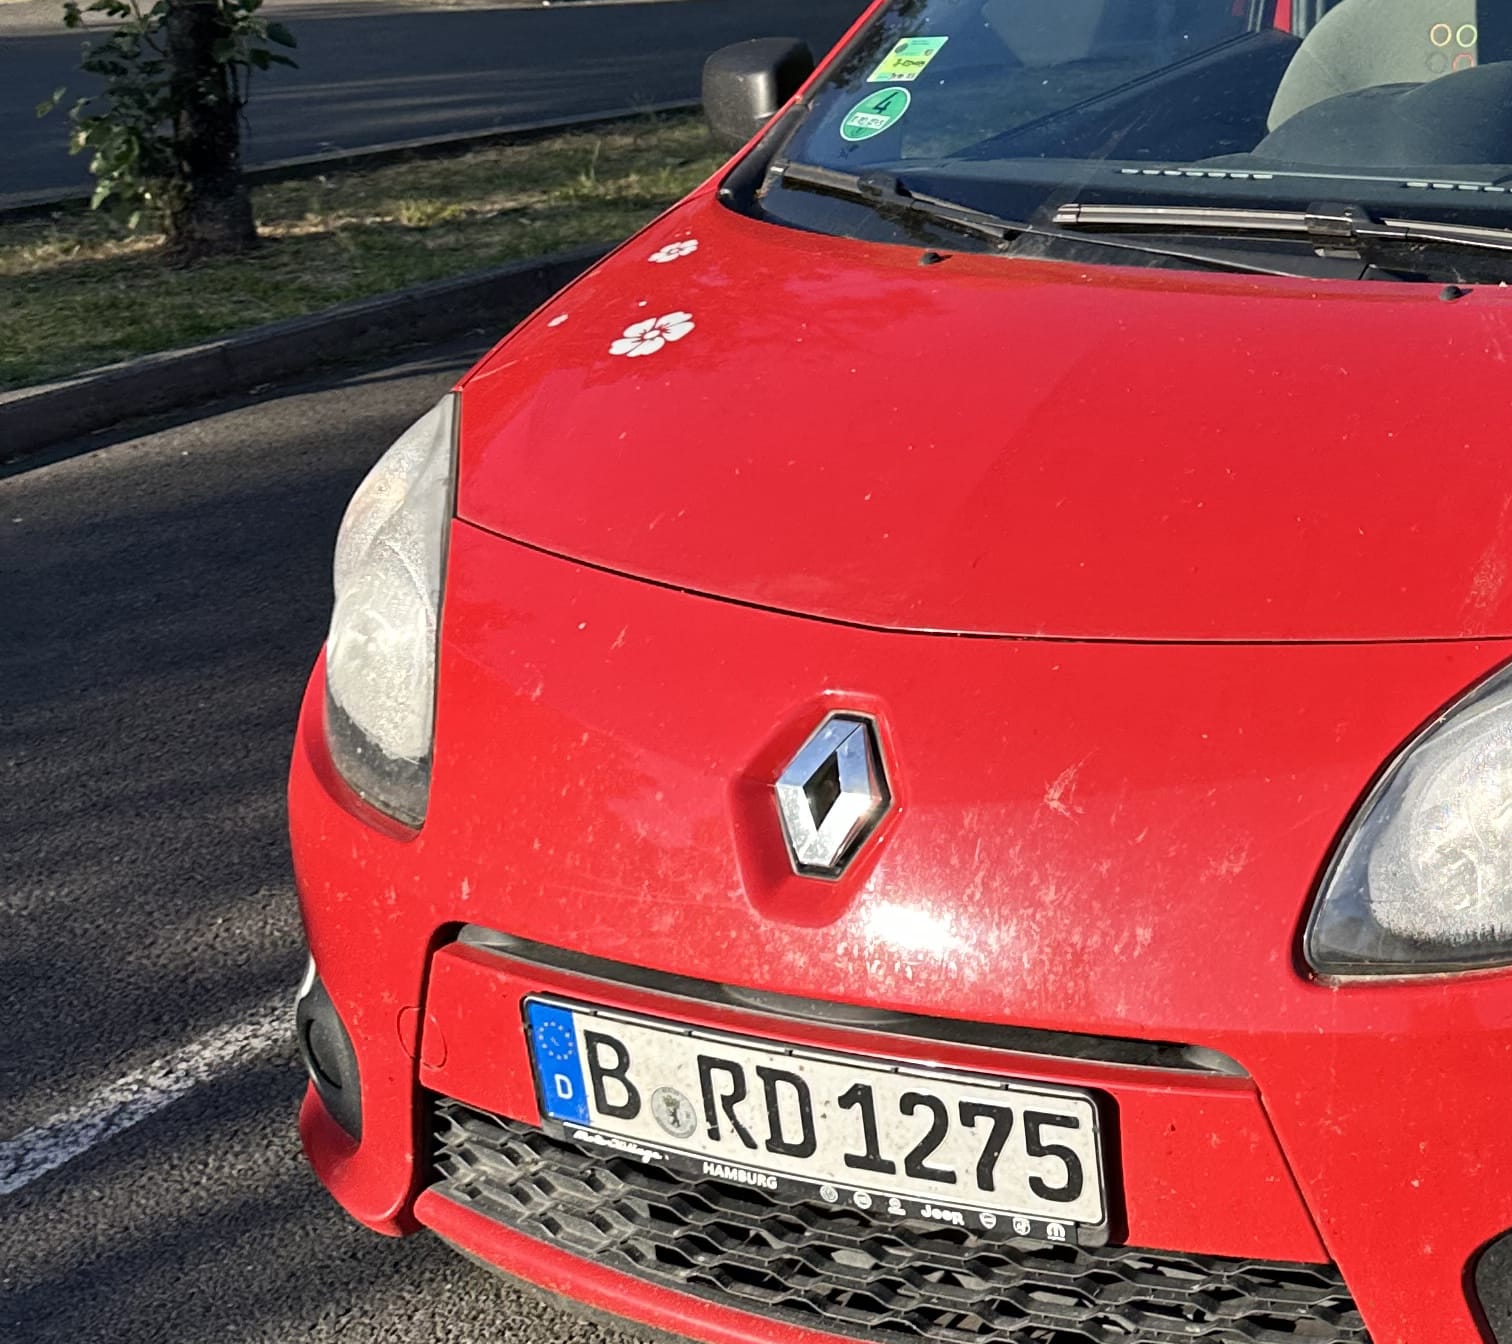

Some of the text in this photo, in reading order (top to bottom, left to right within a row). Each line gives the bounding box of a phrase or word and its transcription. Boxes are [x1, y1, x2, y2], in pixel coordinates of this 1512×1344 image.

[872, 91, 899, 114] 4
[555, 1073, 573, 1099] D
[584, 1029, 1084, 1203] B RD 1275
[702, 1161, 778, 1190] HAMBURG
